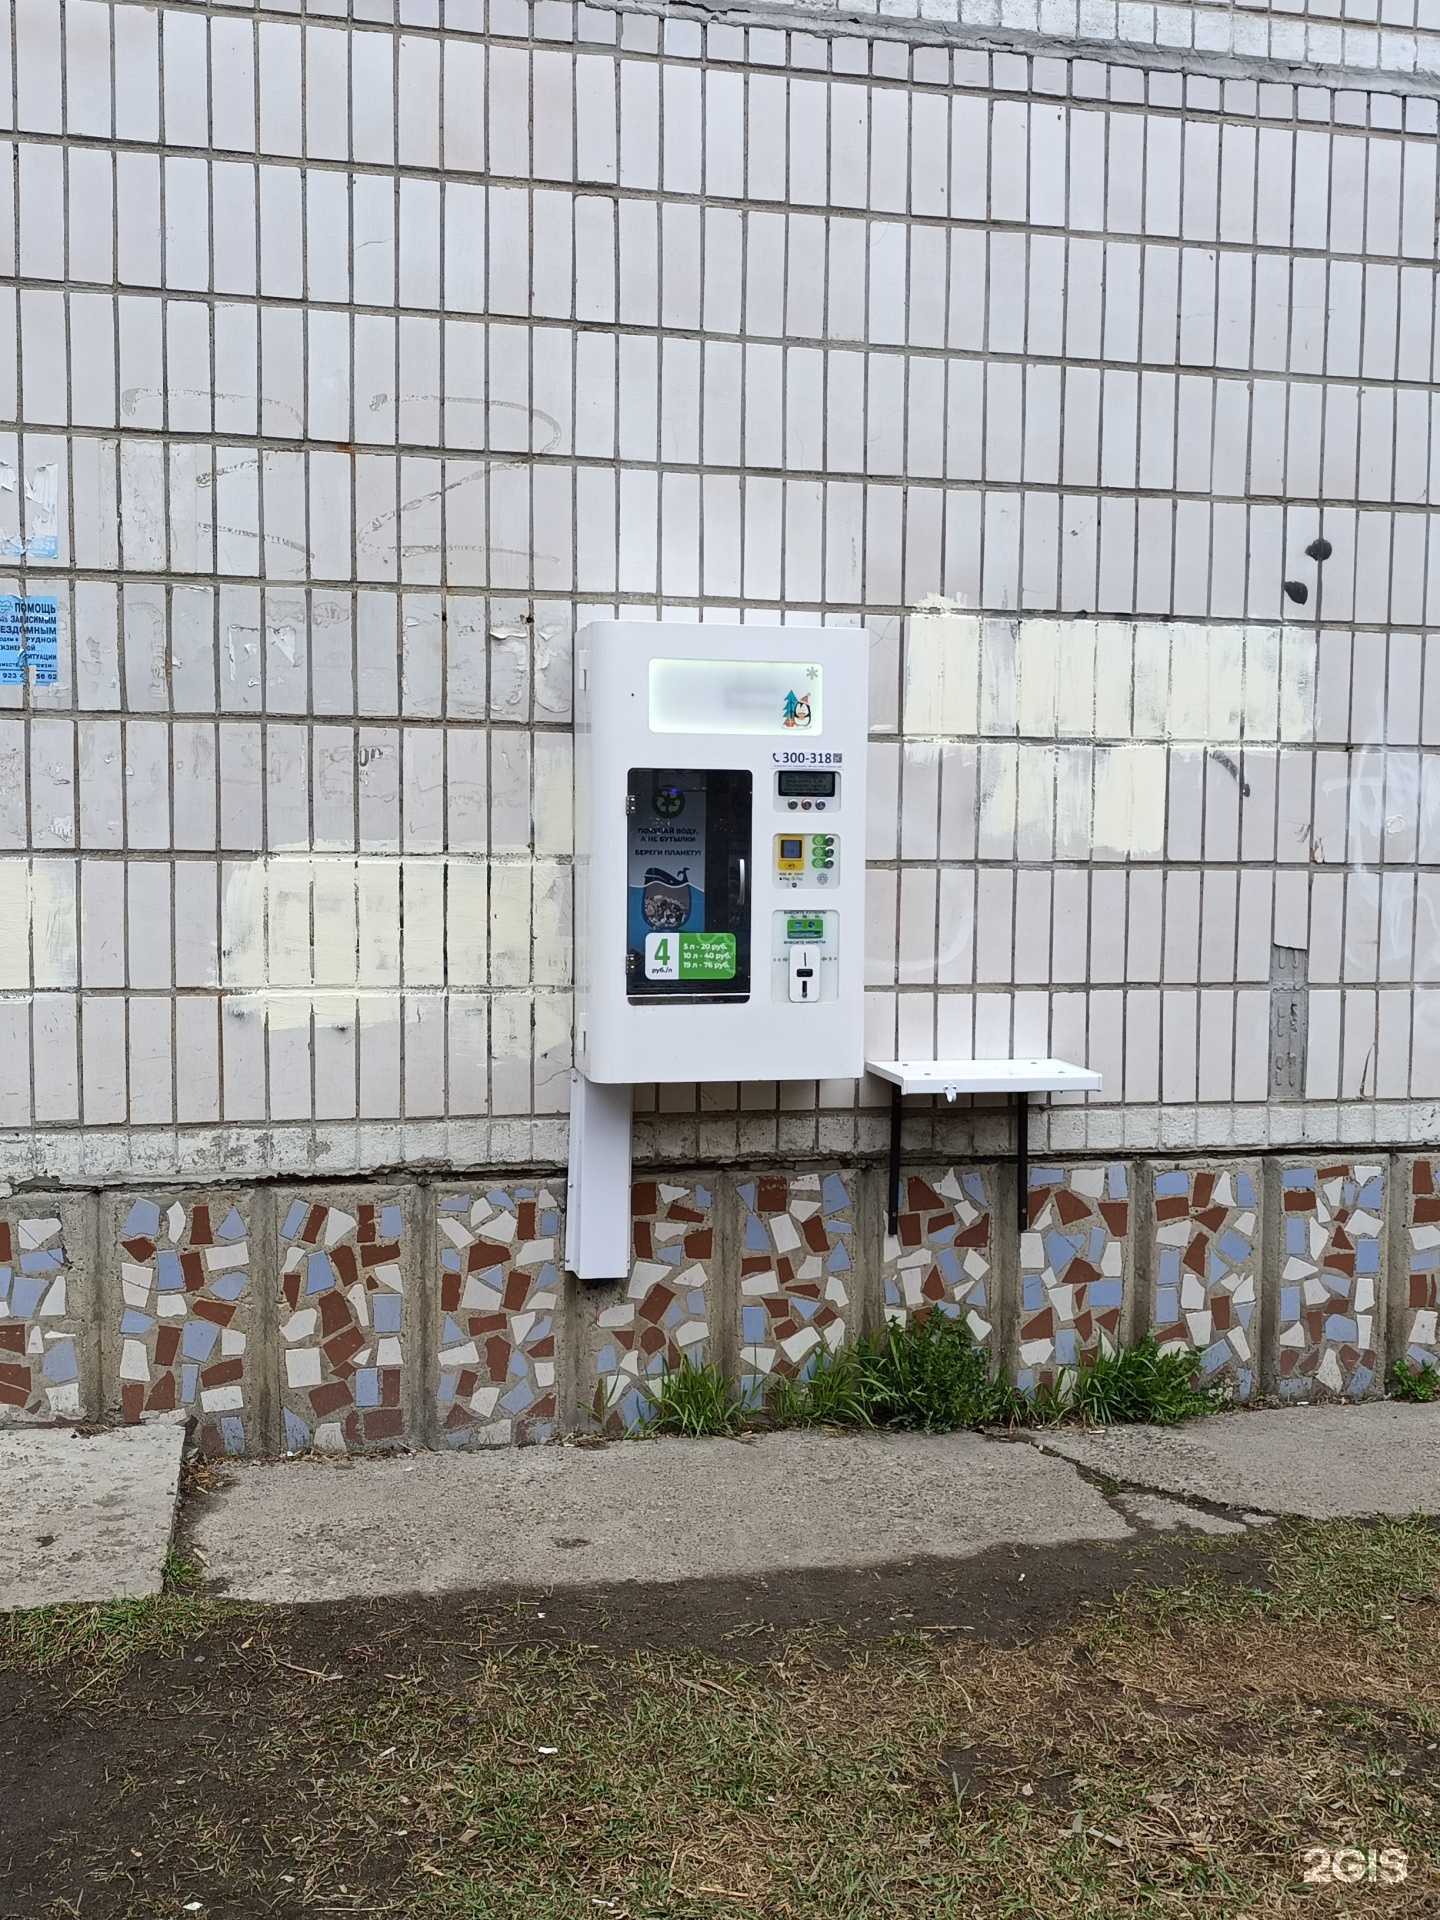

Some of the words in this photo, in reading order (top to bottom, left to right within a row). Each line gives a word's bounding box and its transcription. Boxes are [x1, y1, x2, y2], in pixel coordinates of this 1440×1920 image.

[14, 602, 56, 615] ПОМОЩЬ
[10, 615, 57, 625] ЗАВИСИМЫМ
[0, 625, 57, 635] ЕЗДОМНЫМ
[782, 752, 832, 764] 300-318
[634, 849, 663, 857] БЕРЕГИ
[654, 938, 671, 966] 4
